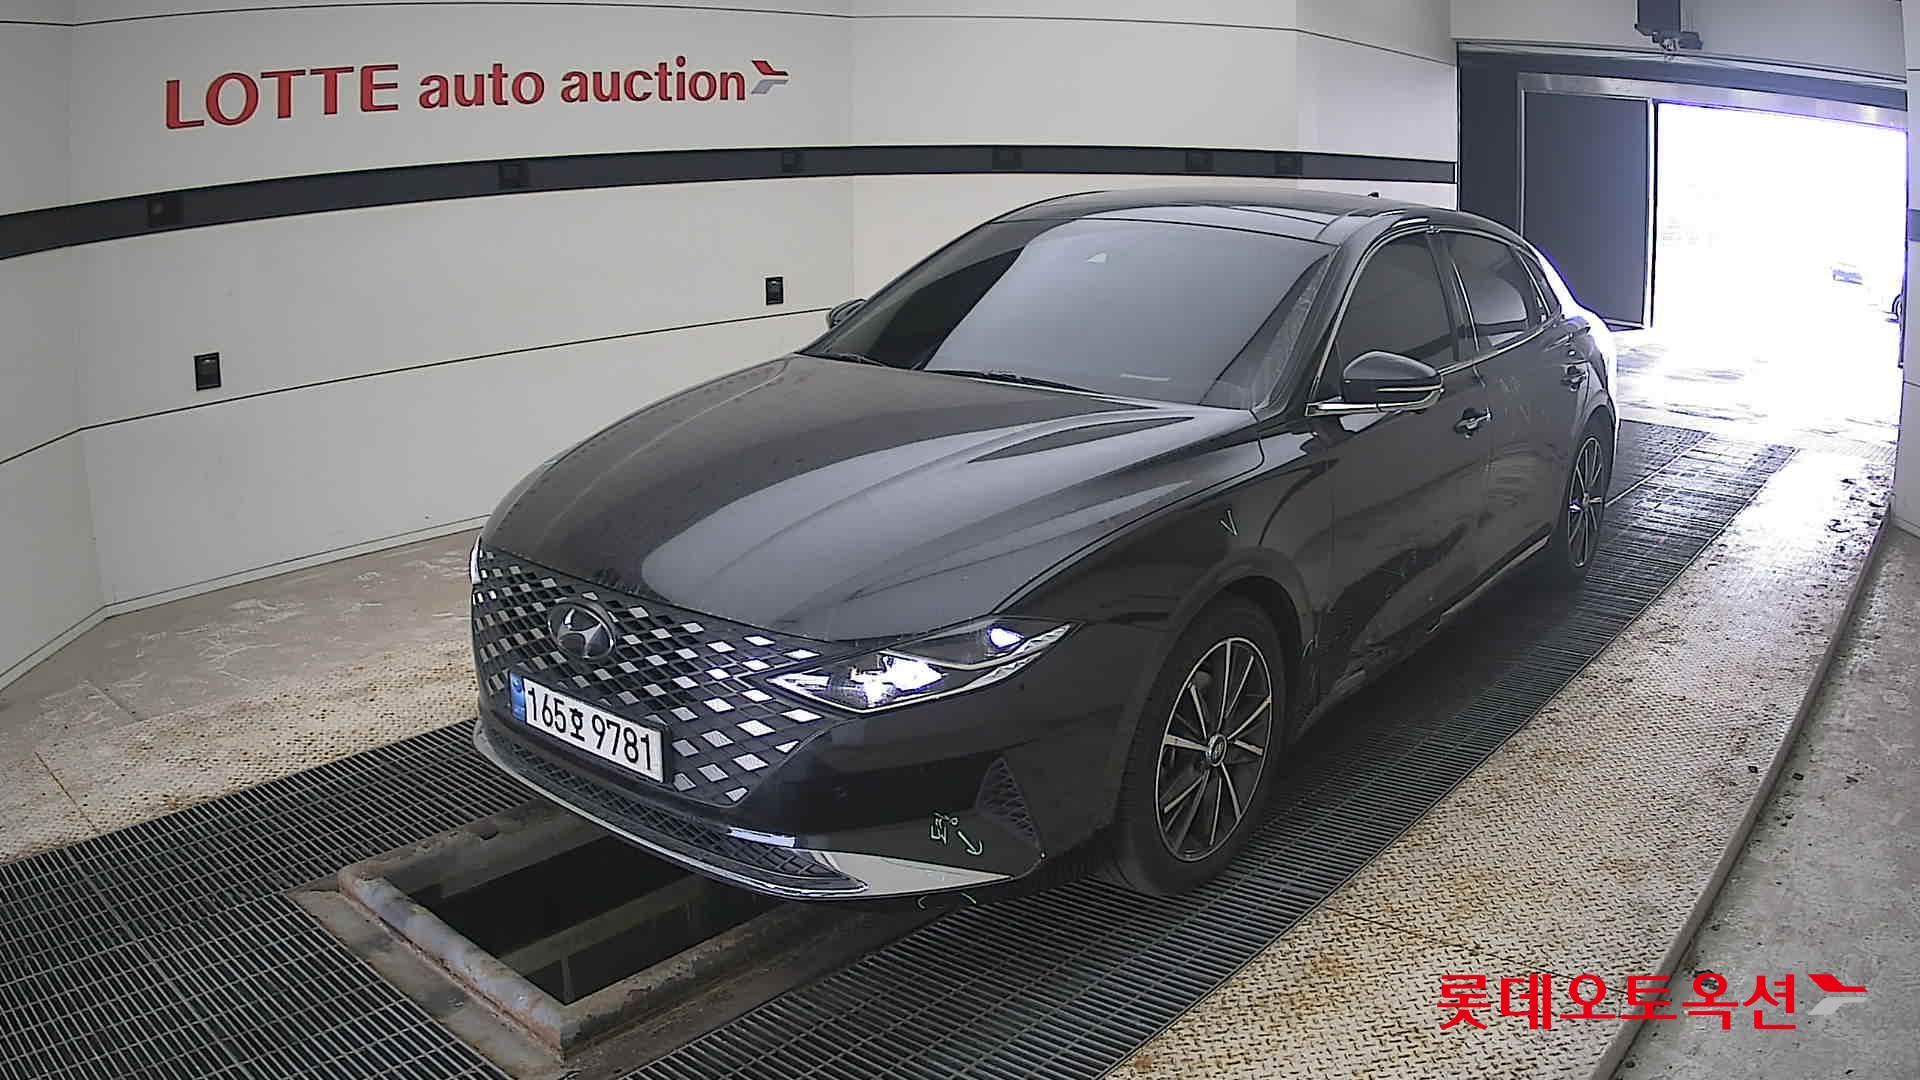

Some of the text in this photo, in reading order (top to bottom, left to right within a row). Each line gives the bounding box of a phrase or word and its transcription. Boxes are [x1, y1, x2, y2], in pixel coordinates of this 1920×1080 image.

[166, 55, 746, 129] LOTTE auto auction
[591, 714, 652, 771] 9781
